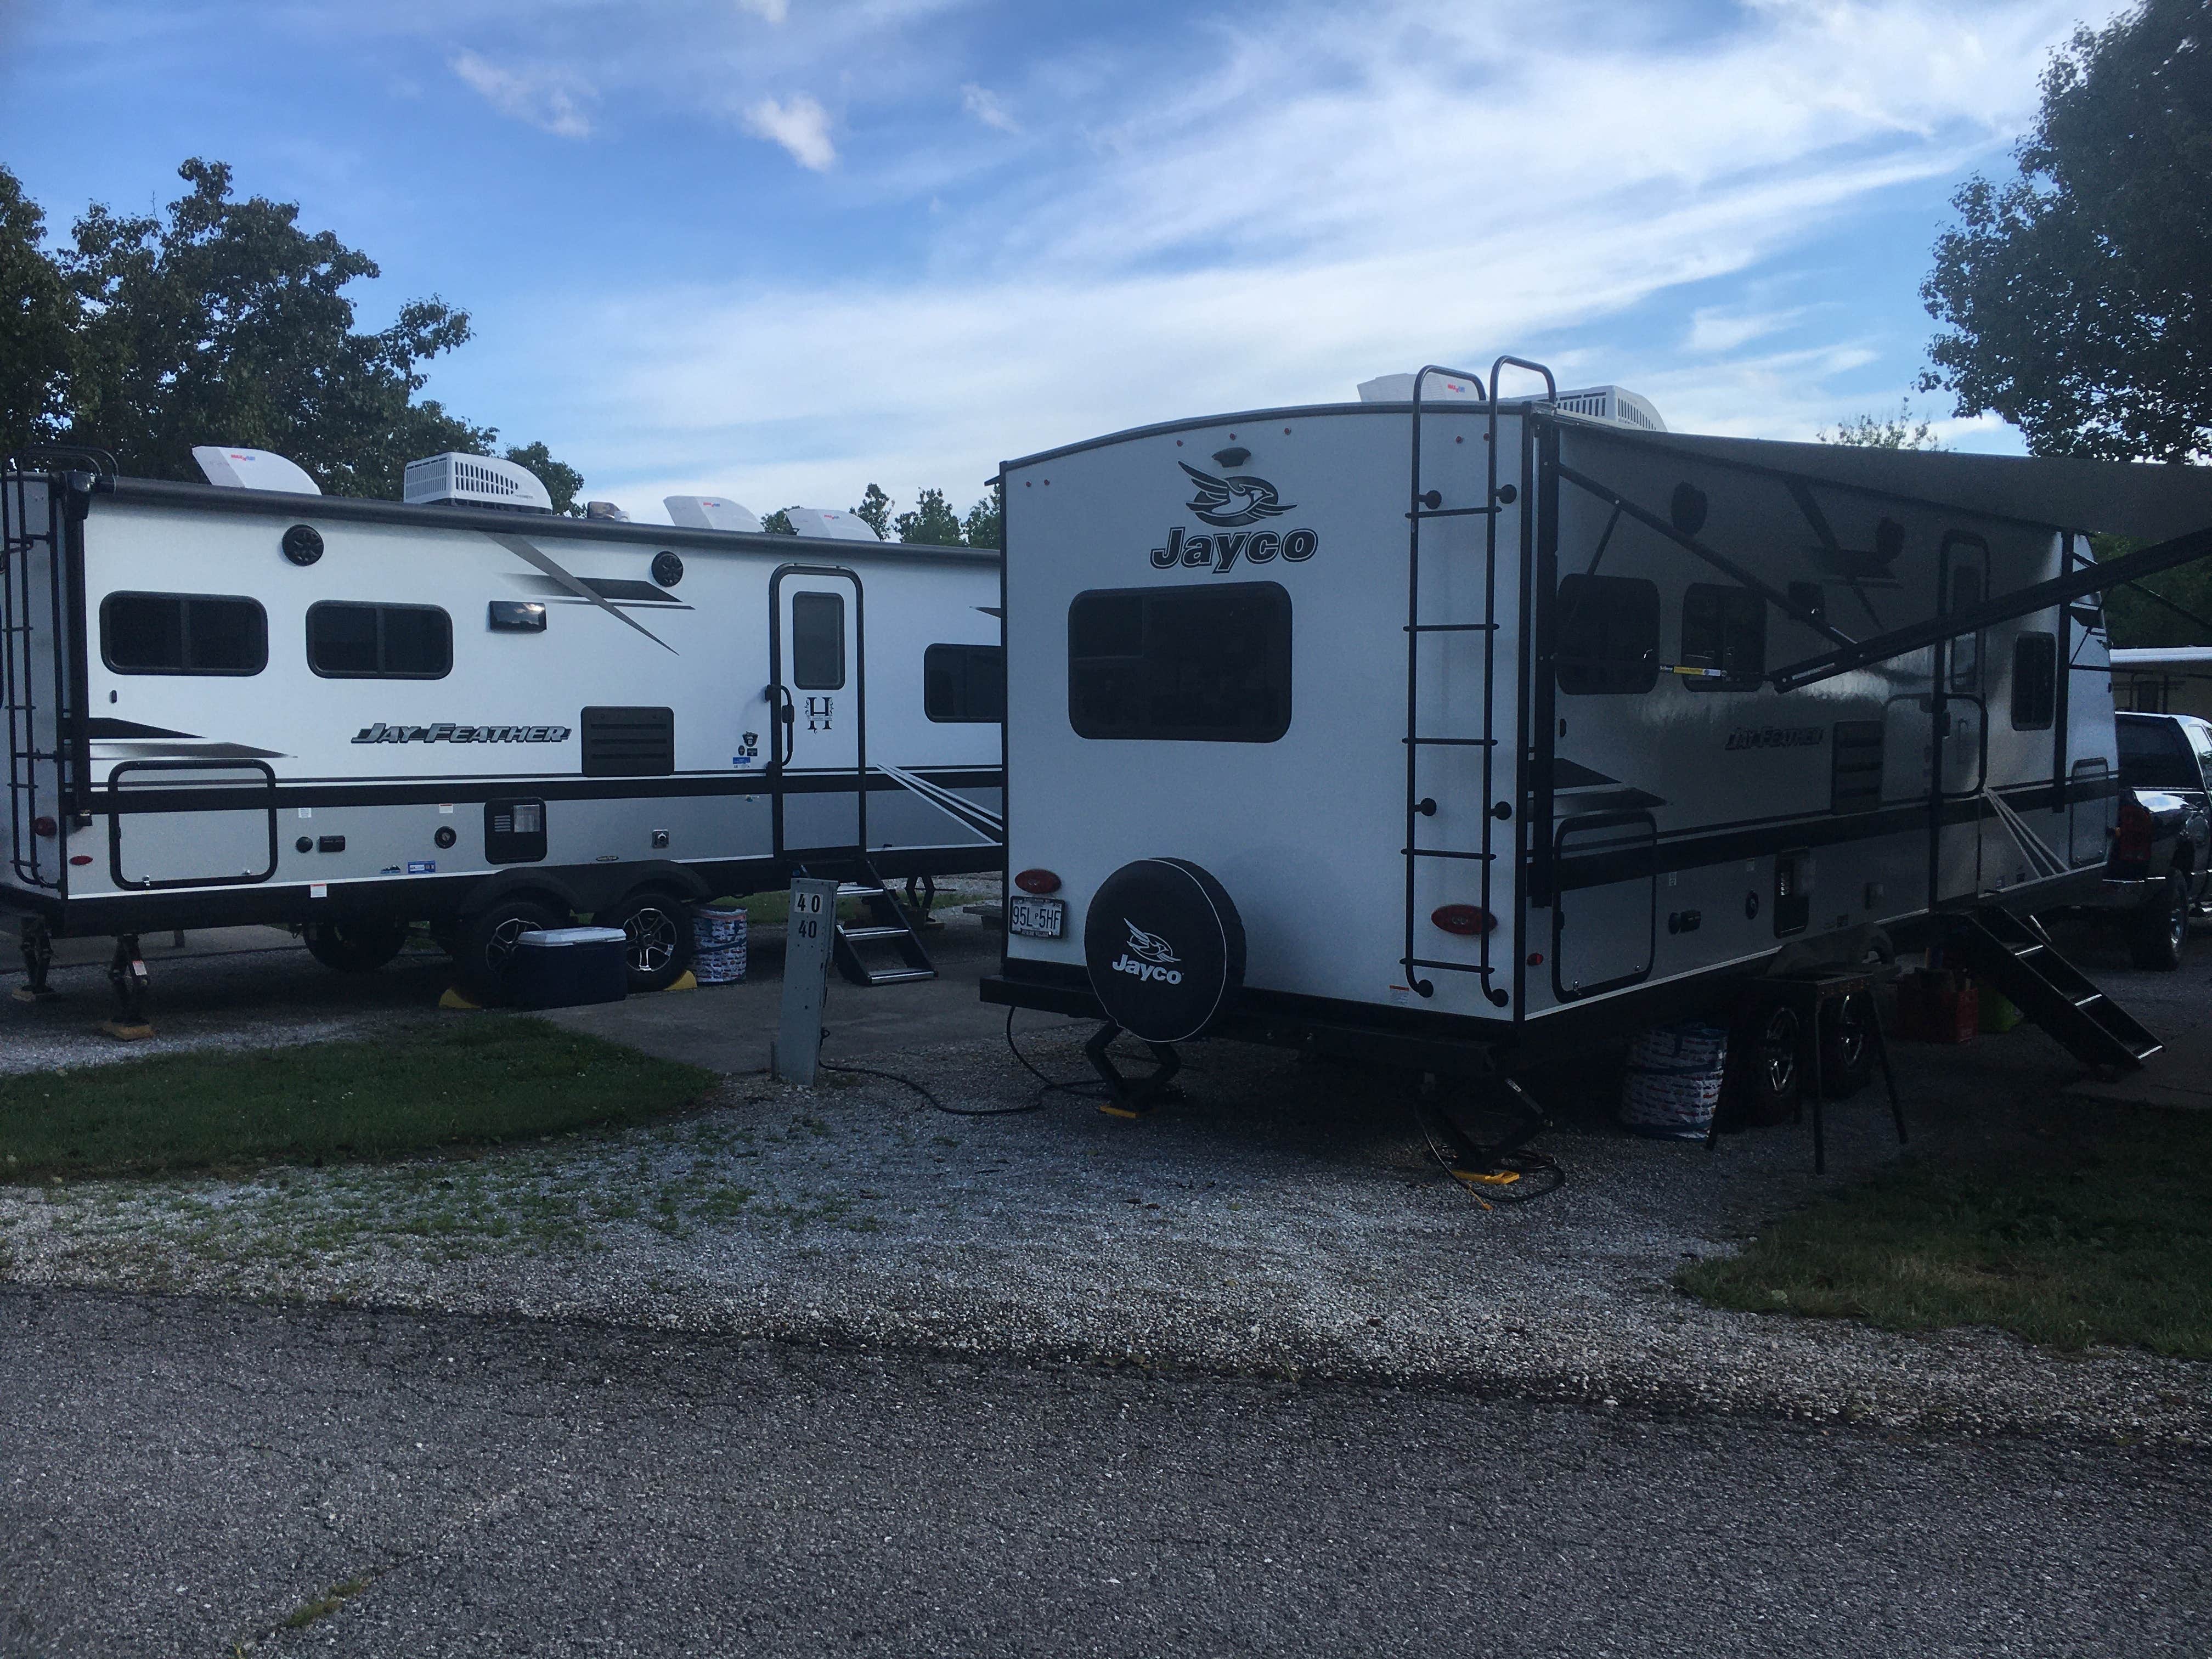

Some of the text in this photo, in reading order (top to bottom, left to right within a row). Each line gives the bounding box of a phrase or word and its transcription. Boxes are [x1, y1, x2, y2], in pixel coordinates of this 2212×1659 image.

[1150, 527, 1318, 574] Jayco
[351, 723, 568, 743] JAY FEATHER
[797, 894, 820, 913] 40
[799, 920, 817, 939] 40
[1112, 953, 1182, 985] Jayco
